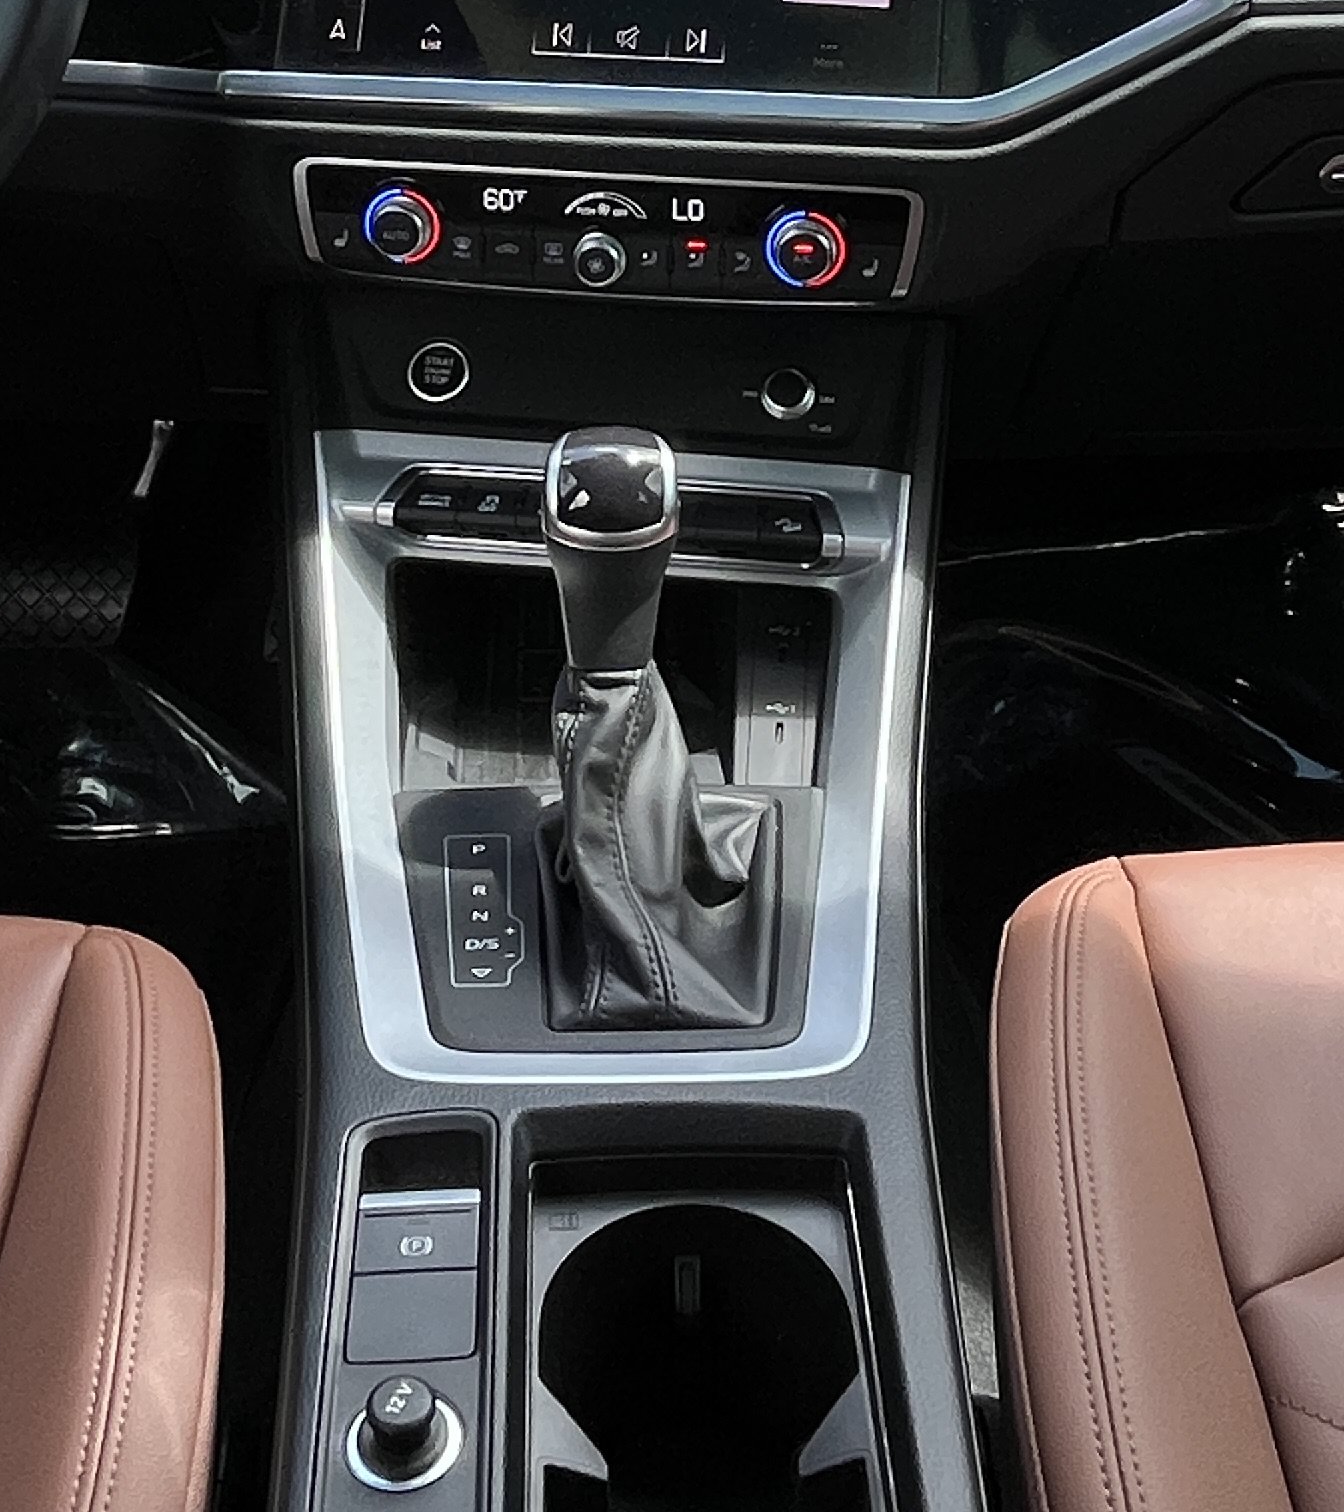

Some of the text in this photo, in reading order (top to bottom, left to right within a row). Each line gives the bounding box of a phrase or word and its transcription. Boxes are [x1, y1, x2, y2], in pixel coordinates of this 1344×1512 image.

[420, 38, 442, 50] List
[671, 197, 705, 223] LO
[382, 230, 410, 241] AUTO
[424, 355, 454, 367] START
[424, 374, 450, 384] STOP
[472, 844, 486, 854] P
[472, 884, 488, 896] R
[472, 910, 489, 922] N
[464, 937, 500, 950] D/S
